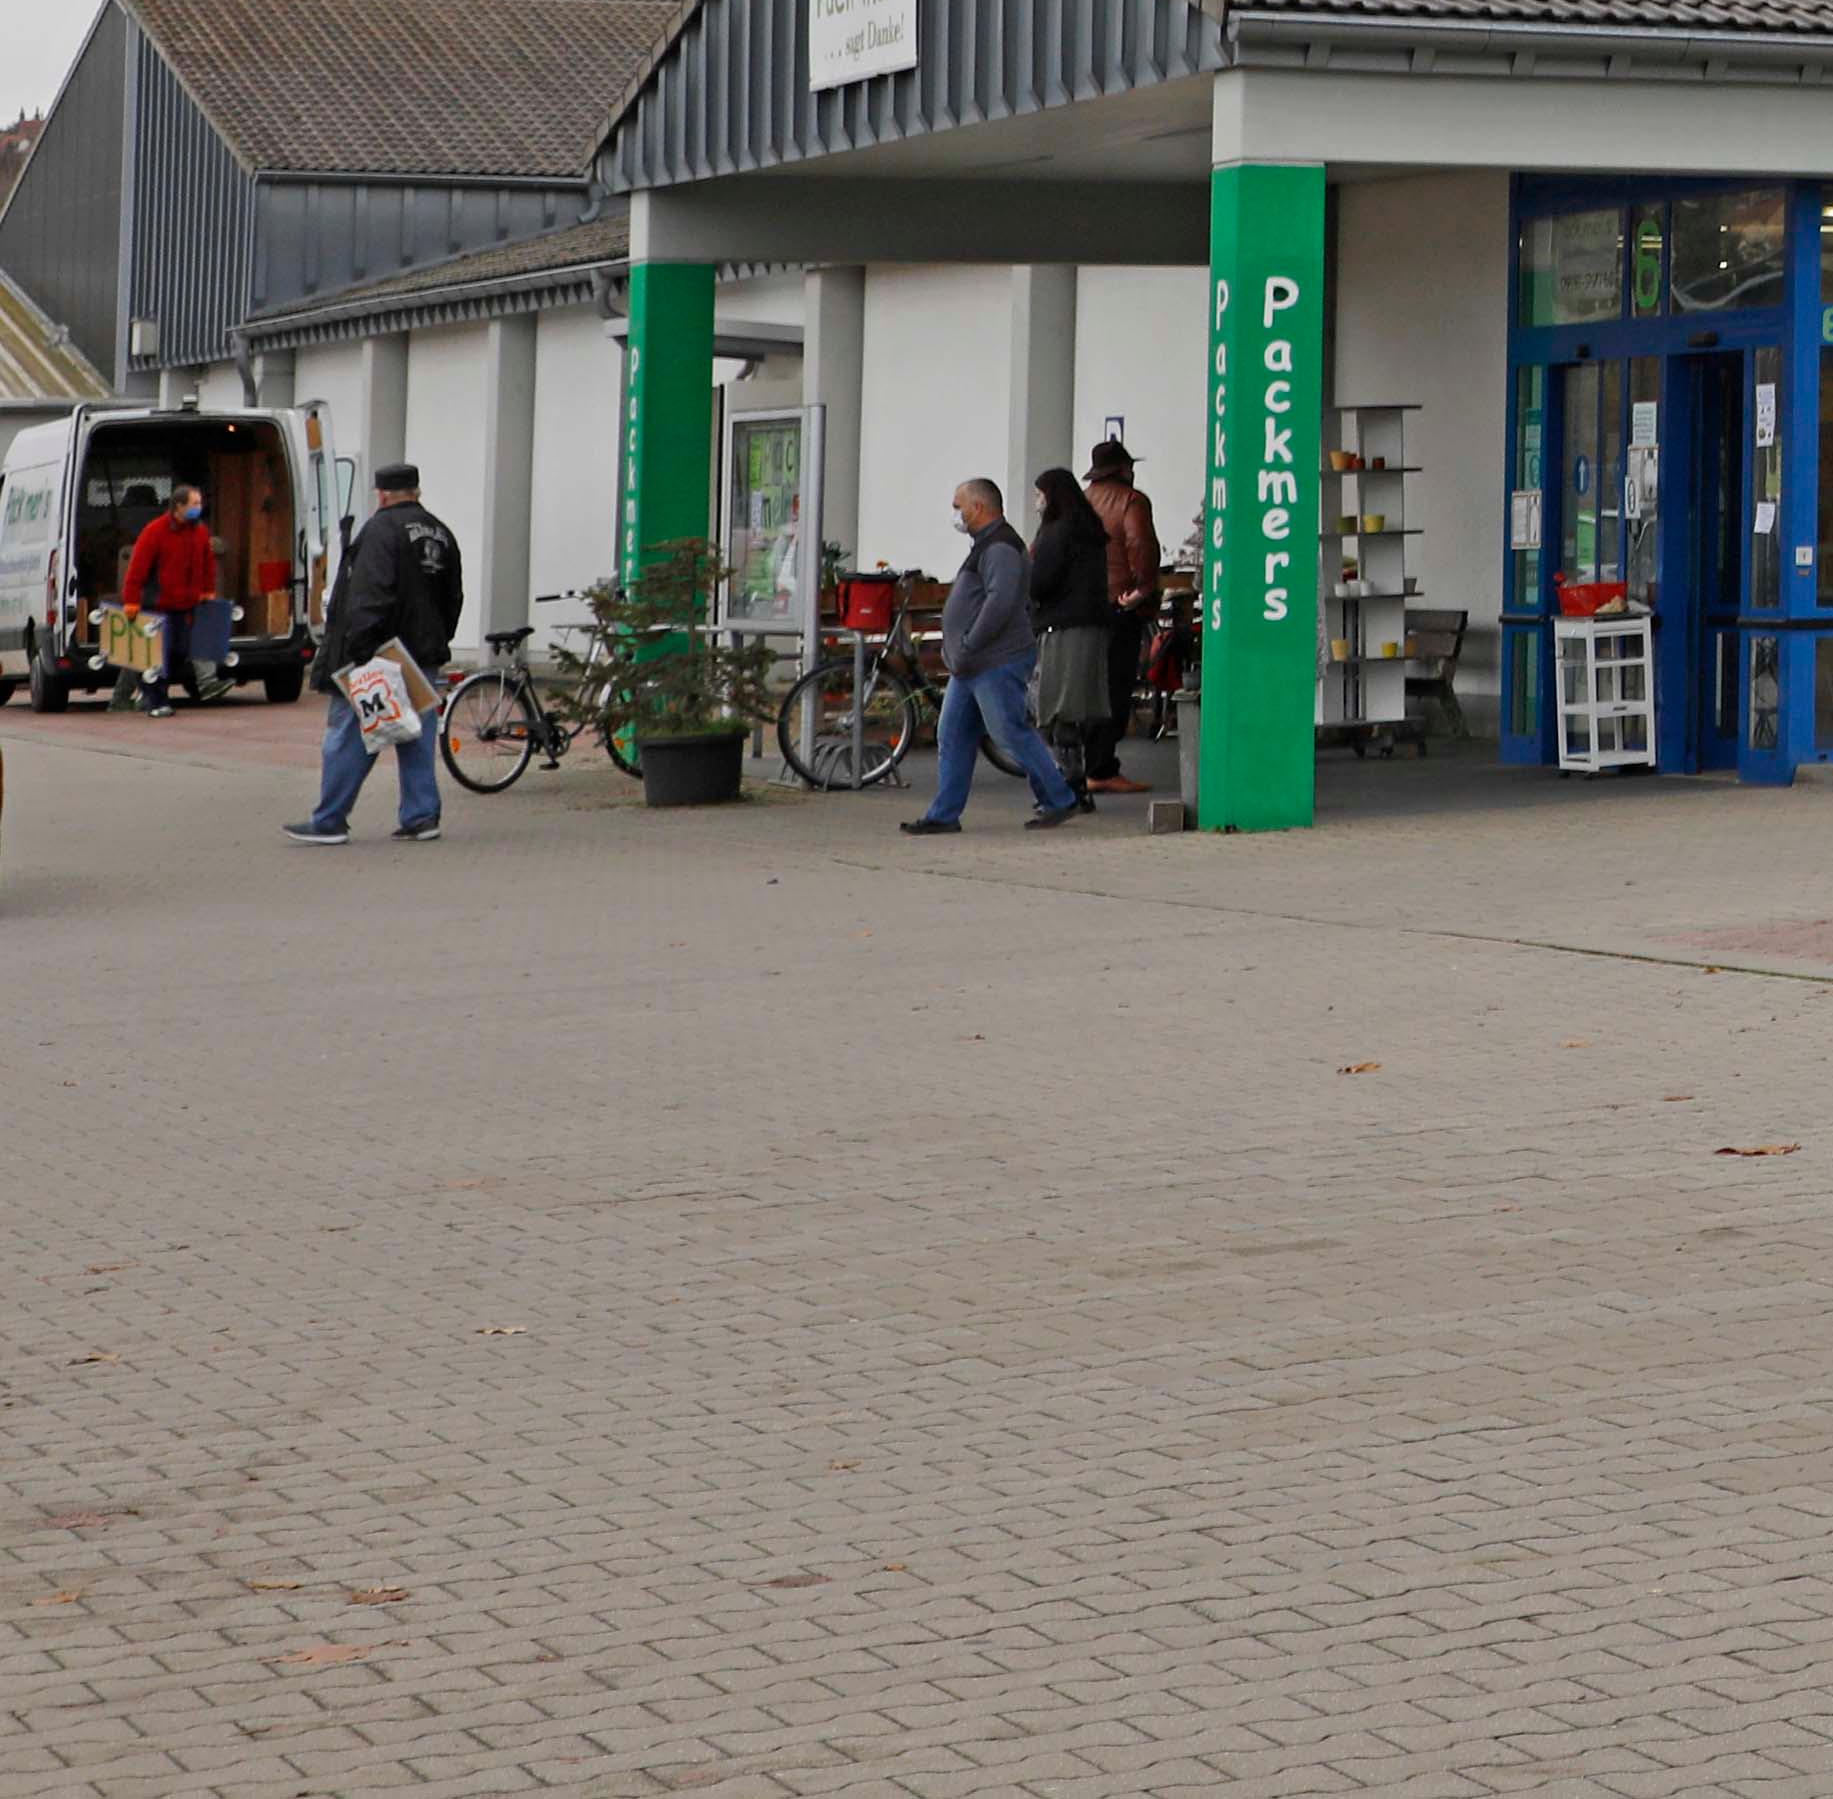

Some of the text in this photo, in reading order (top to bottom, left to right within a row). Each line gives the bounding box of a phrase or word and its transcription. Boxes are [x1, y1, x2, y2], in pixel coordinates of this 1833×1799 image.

[1637, 221, 1661, 308] 6
[1212, 278, 1229, 632] Packmers
[1257, 276, 1300, 621] Packmers
[359, 692, 387, 719] M
